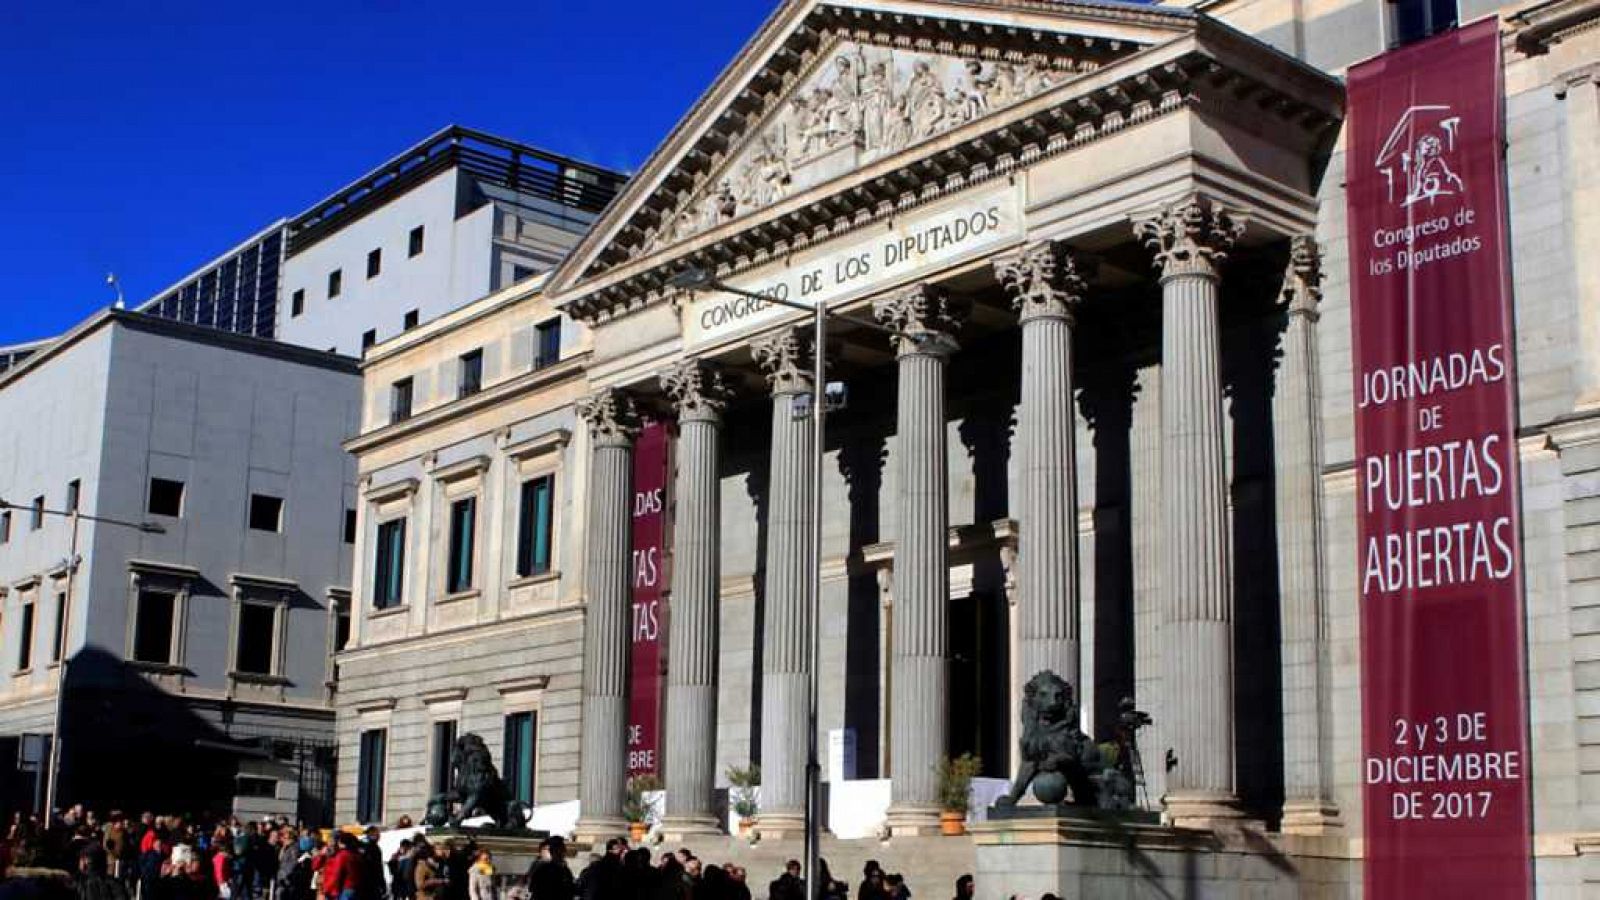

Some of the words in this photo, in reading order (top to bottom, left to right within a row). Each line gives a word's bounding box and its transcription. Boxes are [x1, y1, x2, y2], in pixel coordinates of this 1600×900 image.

[1374, 216, 1449, 248] Congreso
[1454, 207, 1475, 226] de
[701, 282, 788, 331] CONGRESO
[800, 268, 823, 296] DE
[835, 253, 872, 284] LOS
[885, 206, 1000, 268] DIPUTADOS
[1369, 256, 1392, 276] los
[1397, 234, 1481, 270] Diputados
[1359, 344, 1505, 409] JORNADAS
[1419, 405, 1444, 431] DE
[1366, 434, 1503, 513] PUERTAS
[633, 488, 662, 517] DAS
[1363, 516, 1513, 595] ABIERTAS
[632, 600, 659, 643] TAS
[1395, 718, 1409, 745] 2
[1416, 724, 1428, 751] y
[1435, 716, 1449, 743] 3
[1457, 712, 1487, 742] DE
[1366, 751, 1521, 785] DICIEMBRE
[1393, 792, 1424, 820] DE
[1431, 791, 1493, 820] 2017
